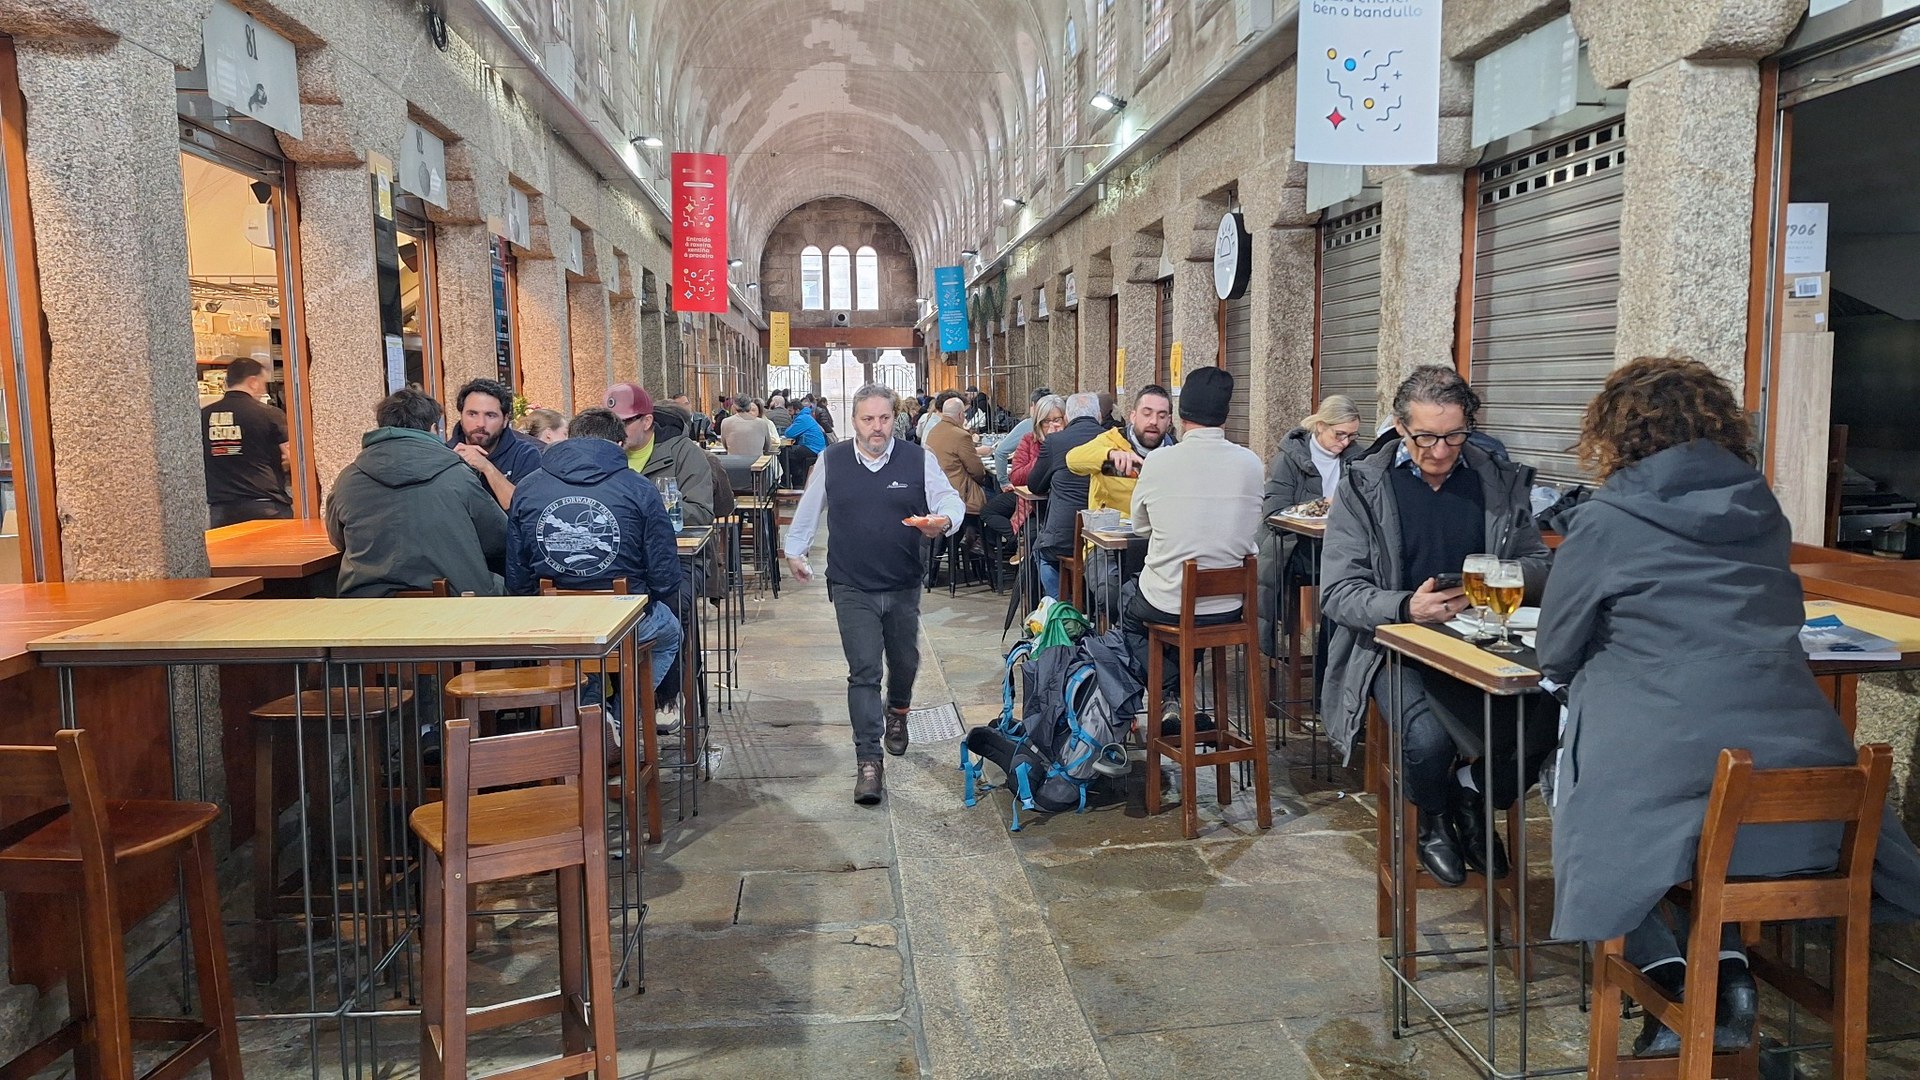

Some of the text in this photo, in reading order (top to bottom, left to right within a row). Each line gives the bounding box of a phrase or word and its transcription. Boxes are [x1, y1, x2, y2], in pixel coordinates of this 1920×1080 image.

[1312, 1, 1422, 18] ben o bandullo
[245, 24, 258, 60] 81
[537, 496, 620, 535] ENHANCED FORWARD PRESENCE
[545, 558, 566, 573] ACERO
[574, 569, 587, 577] VII
